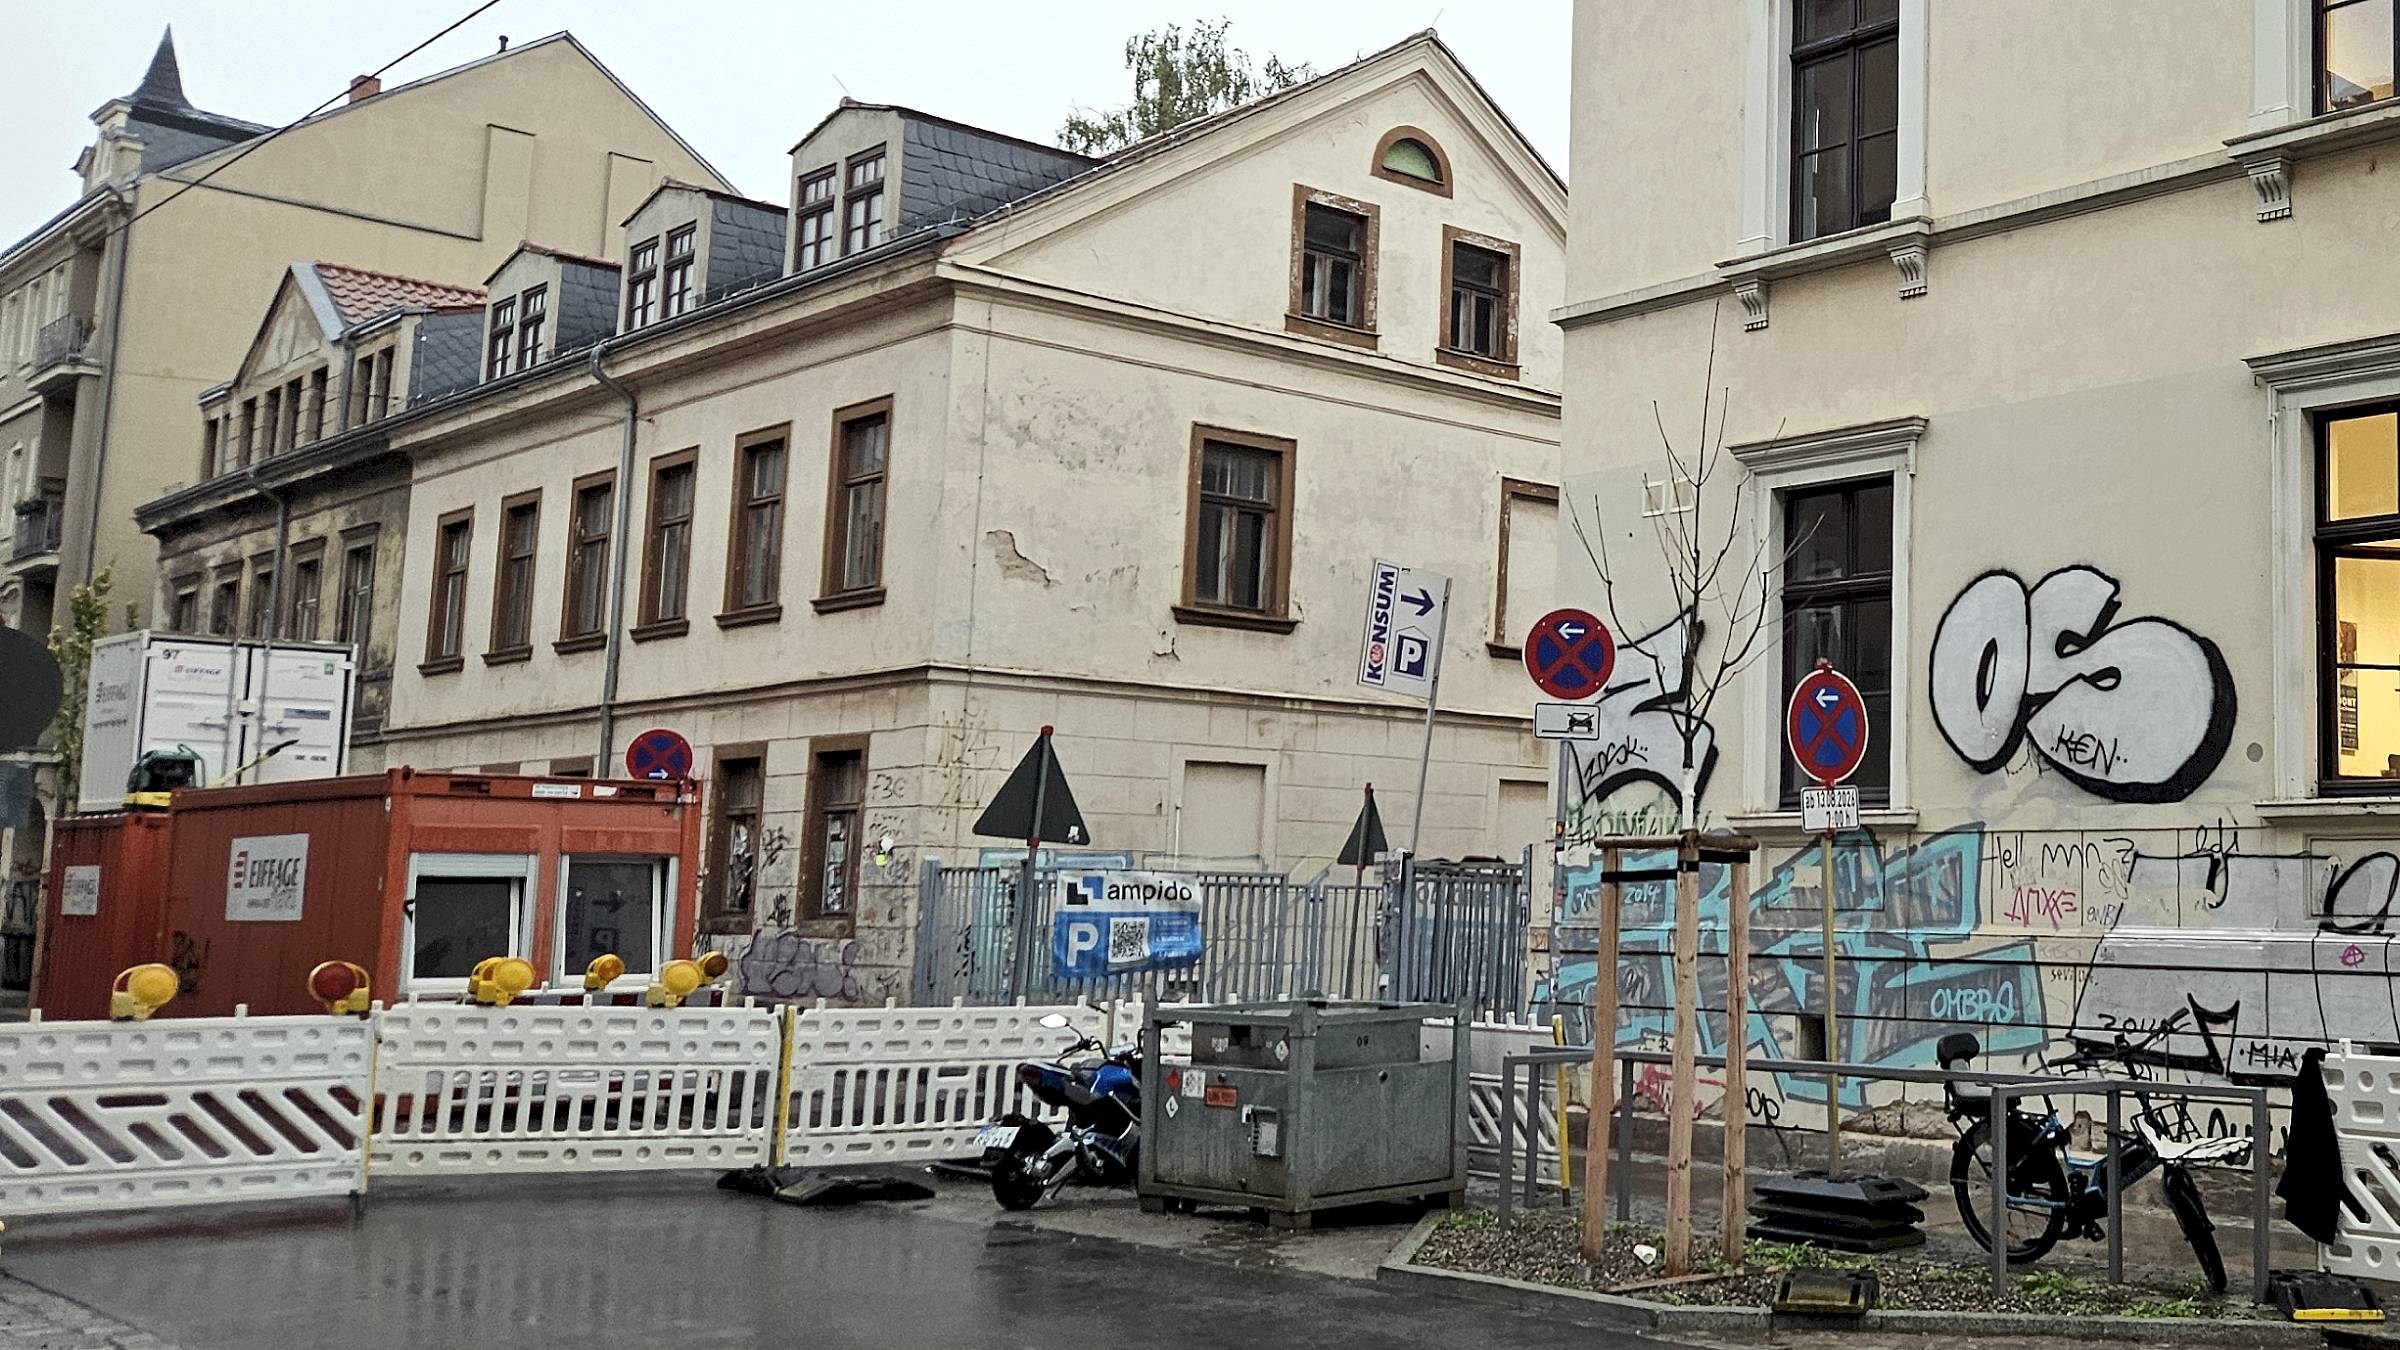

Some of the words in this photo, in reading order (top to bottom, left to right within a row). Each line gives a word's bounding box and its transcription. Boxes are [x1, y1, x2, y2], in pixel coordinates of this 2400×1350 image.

[1366, 571, 1395, 680] KONSUM
[162, 649, 181, 660] 97
[1400, 638, 1423, 672] P
[1806, 793, 1815, 808] ab
[249, 857, 300, 888] EIFFAGE
[1107, 880, 1193, 905] ampido
[1066, 922, 1099, 967] P
